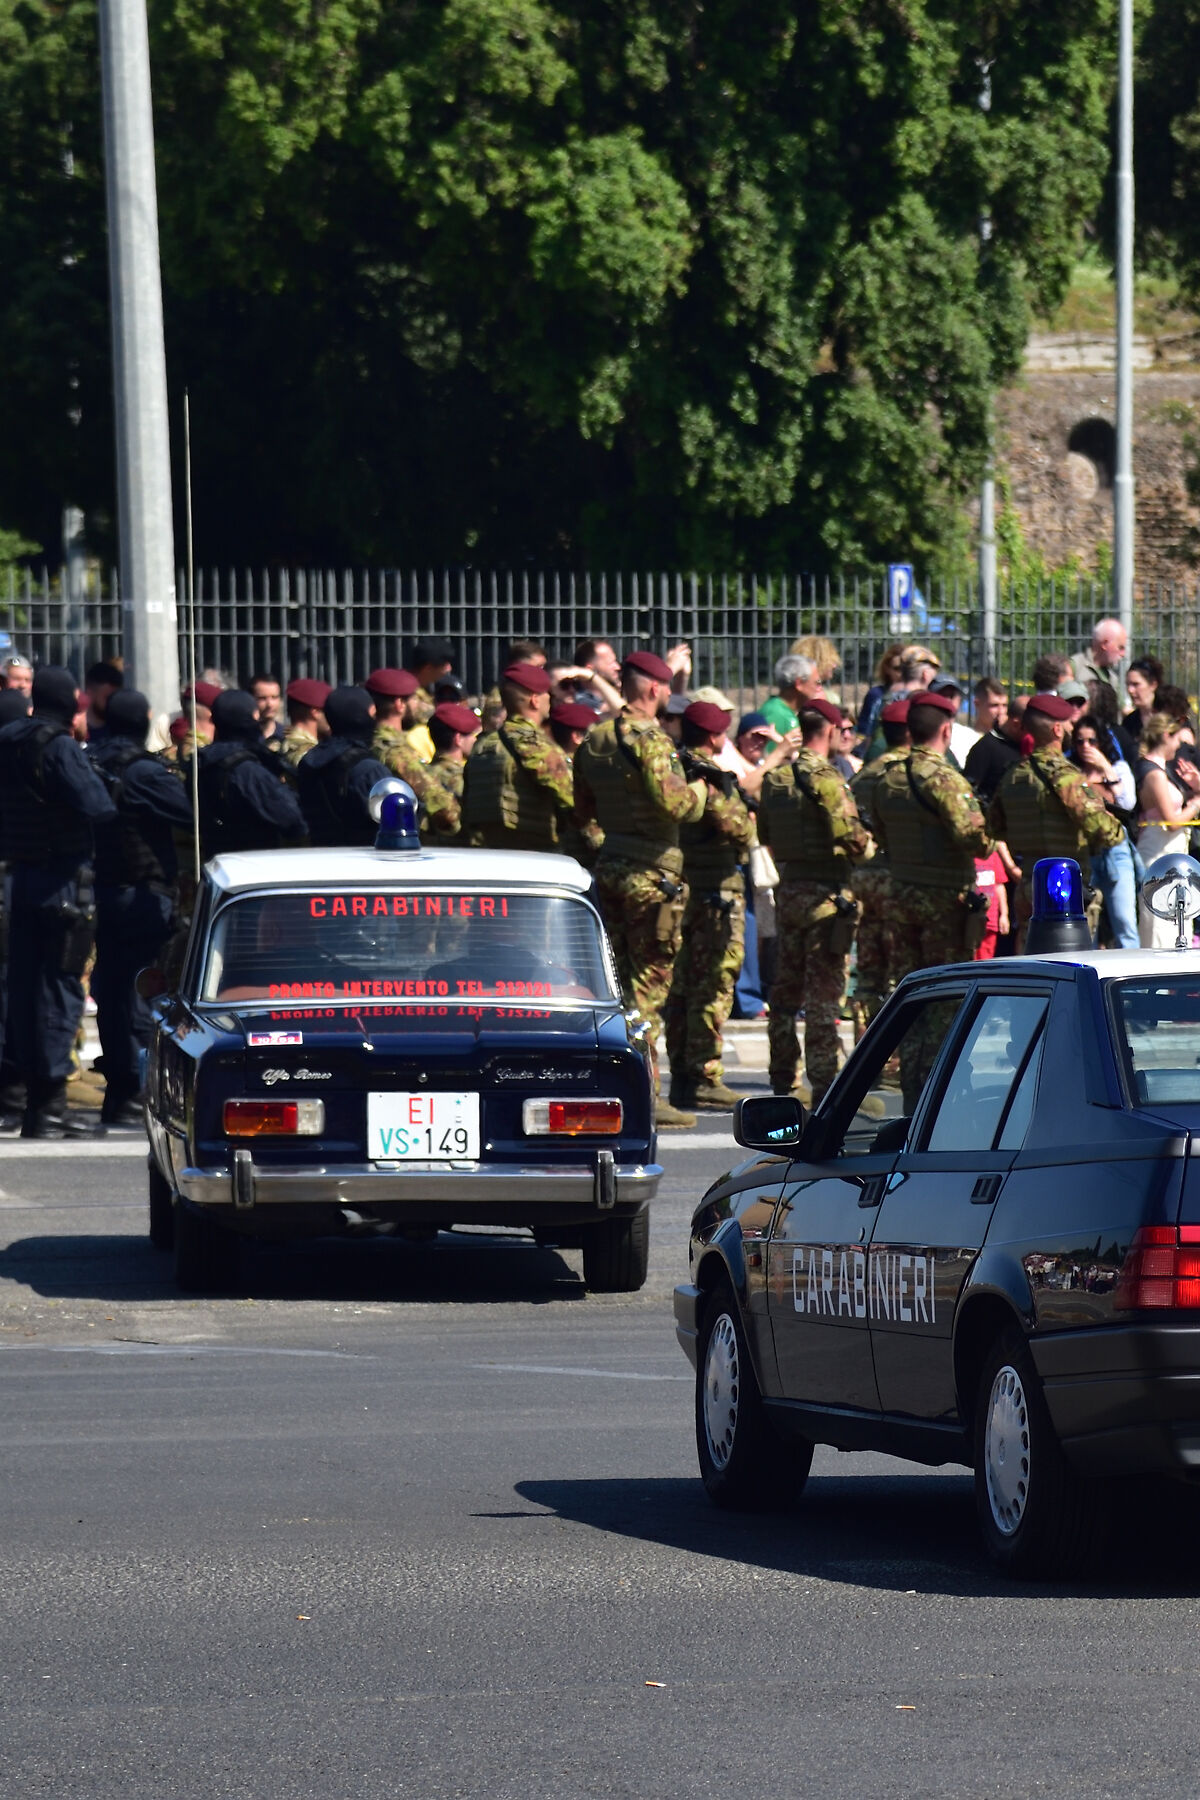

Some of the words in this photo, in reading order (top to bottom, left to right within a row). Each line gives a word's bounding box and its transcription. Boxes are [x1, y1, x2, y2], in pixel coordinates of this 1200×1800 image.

[892, 569, 909, 610] P
[309, 896, 508, 917] CARABINIERI
[268, 983, 336, 999] PRONTO
[343, 980, 449, 997] INTERVENTO
[495, 980, 551, 998] 212121
[409, 1098, 434, 1124] EI
[425, 1127, 468, 1154] 149
[793, 1248, 936, 1323] CARABINIERI
